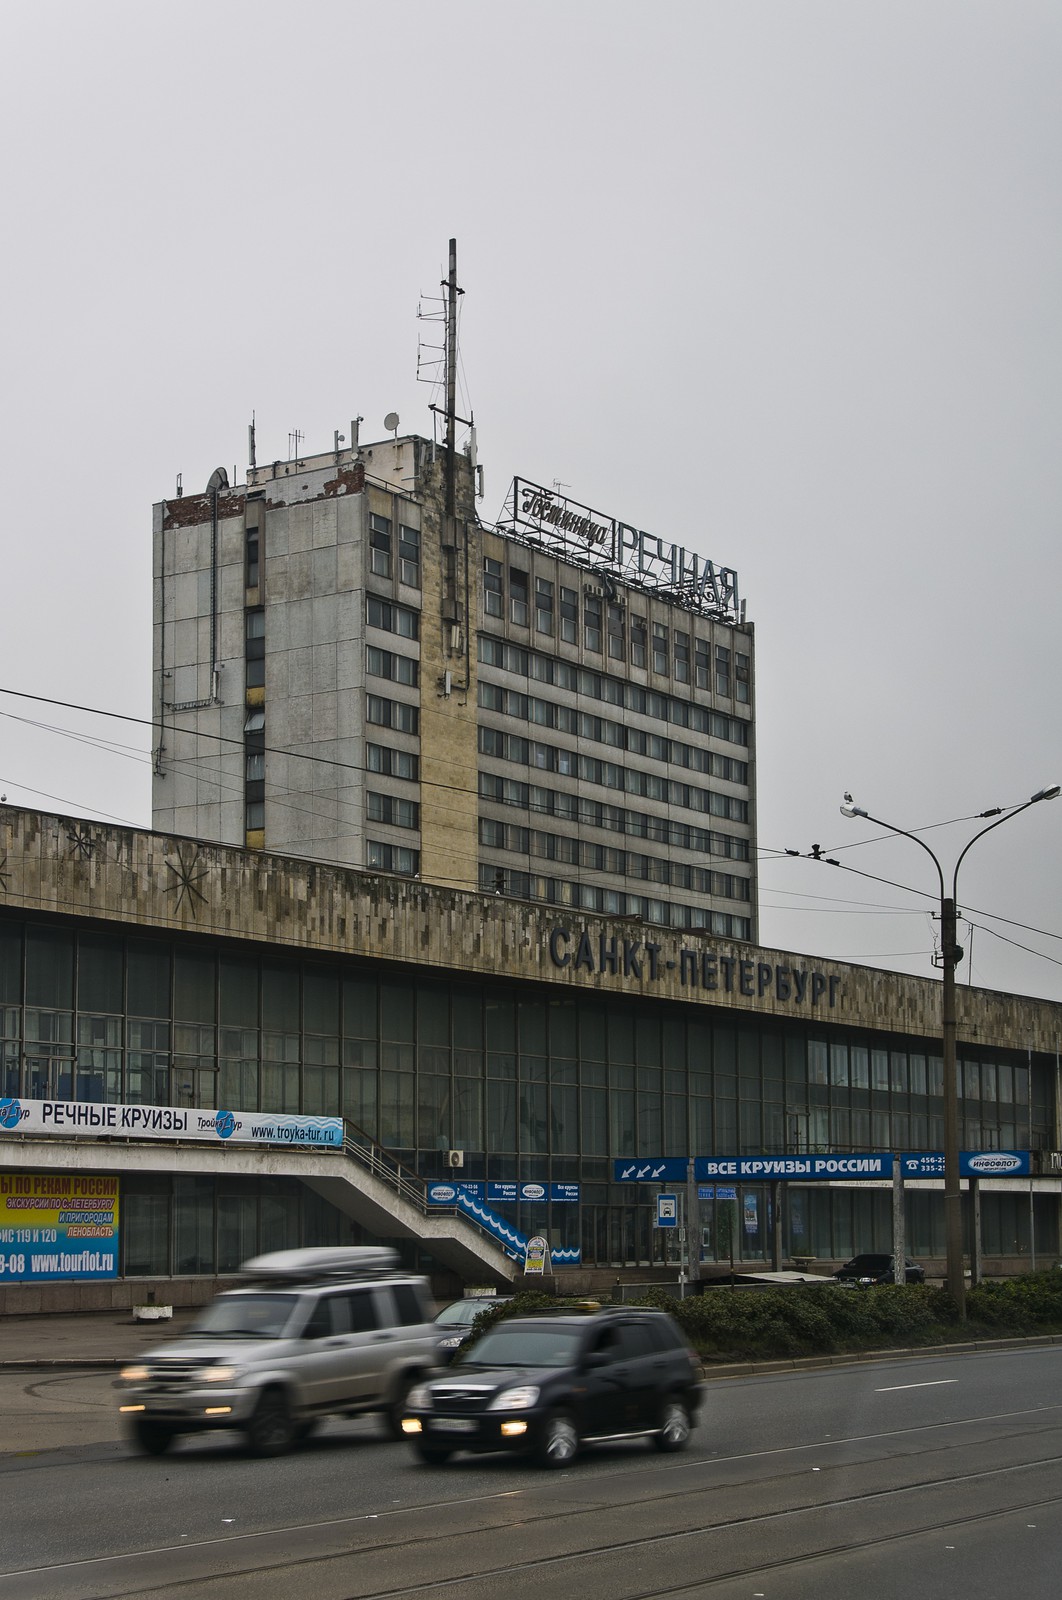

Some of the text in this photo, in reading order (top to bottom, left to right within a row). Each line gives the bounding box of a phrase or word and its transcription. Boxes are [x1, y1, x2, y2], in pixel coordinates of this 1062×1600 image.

[617, 521, 738, 611] РЕЧНАЯ
[549, 927, 842, 1008] САНКТ-ПЕТЕРБУРГ
[42, 1103, 187, 1131] РЕЧНЫЕ КРУИЗЫ
[707, 1159, 881, 1175] ВСЕ КРУИЗЫ РОССИИ
[15, 1177, 31, 1194] ПО
[34, 1177, 71, 1195] РЕКАМ
[74, 1178, 117, 1195] РОССИИ
[7, 1197, 49, 1208] ЭКСКУРСИИ
[50, 1198, 61, 1209] ПО
[59, 1212, 113, 1224] И ПРИГОРОДАМ
[0, 1229, 57, 1243] ИС 119 И 120
[67, 1226, 113, 1237] ЛЕНОБЛАСТЬ
[31, 1250, 114, 1273] www.tourflot.ru
